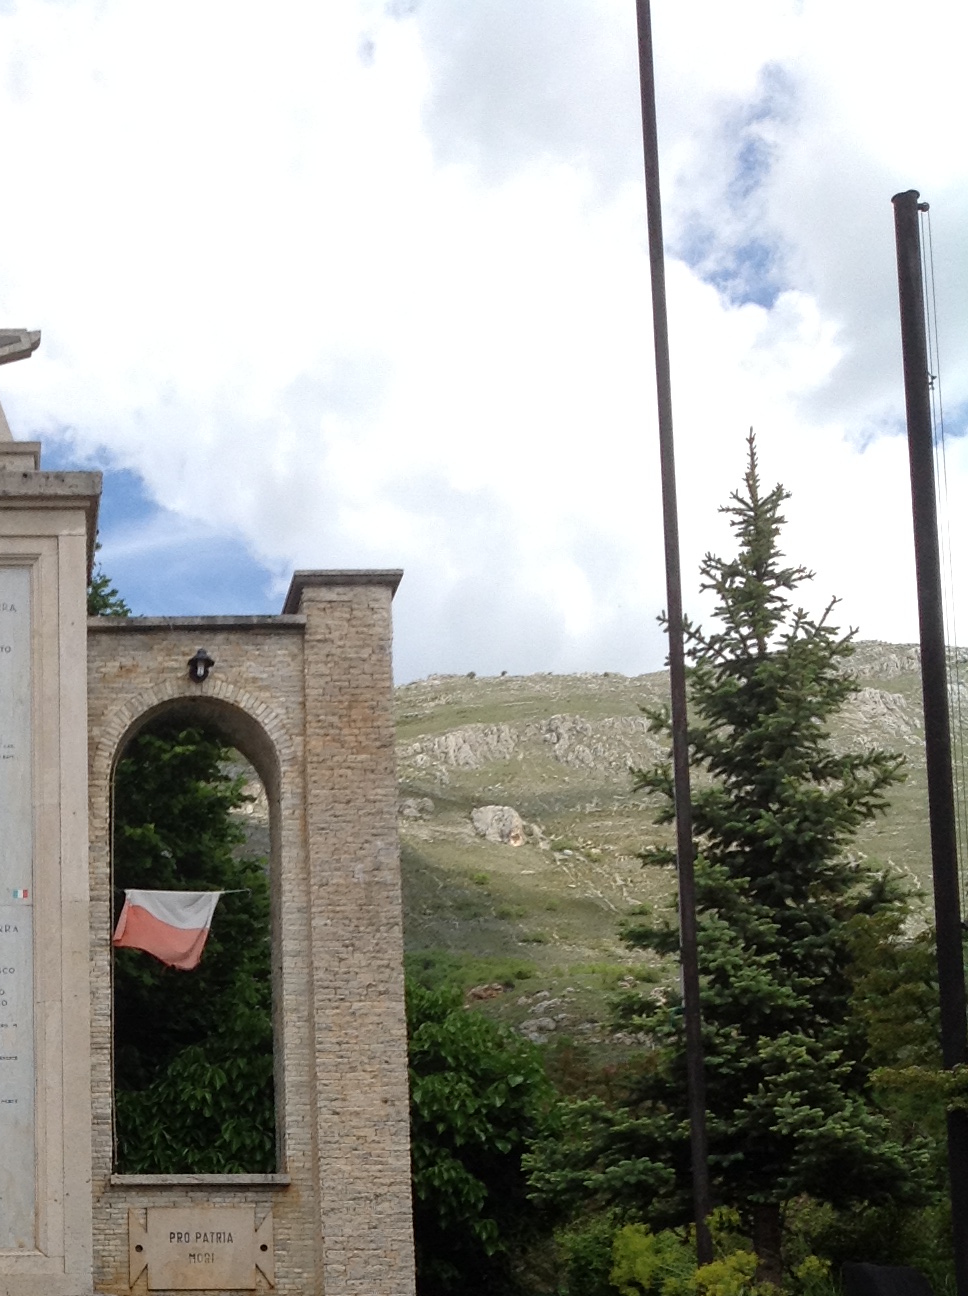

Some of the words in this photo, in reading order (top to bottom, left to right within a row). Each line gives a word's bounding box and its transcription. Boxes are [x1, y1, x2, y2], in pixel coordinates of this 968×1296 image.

[170, 1232, 190, 1243] PRO
[196, 1232, 233, 1243] PATRIA
[189, 1253, 214, 1263] MORI
